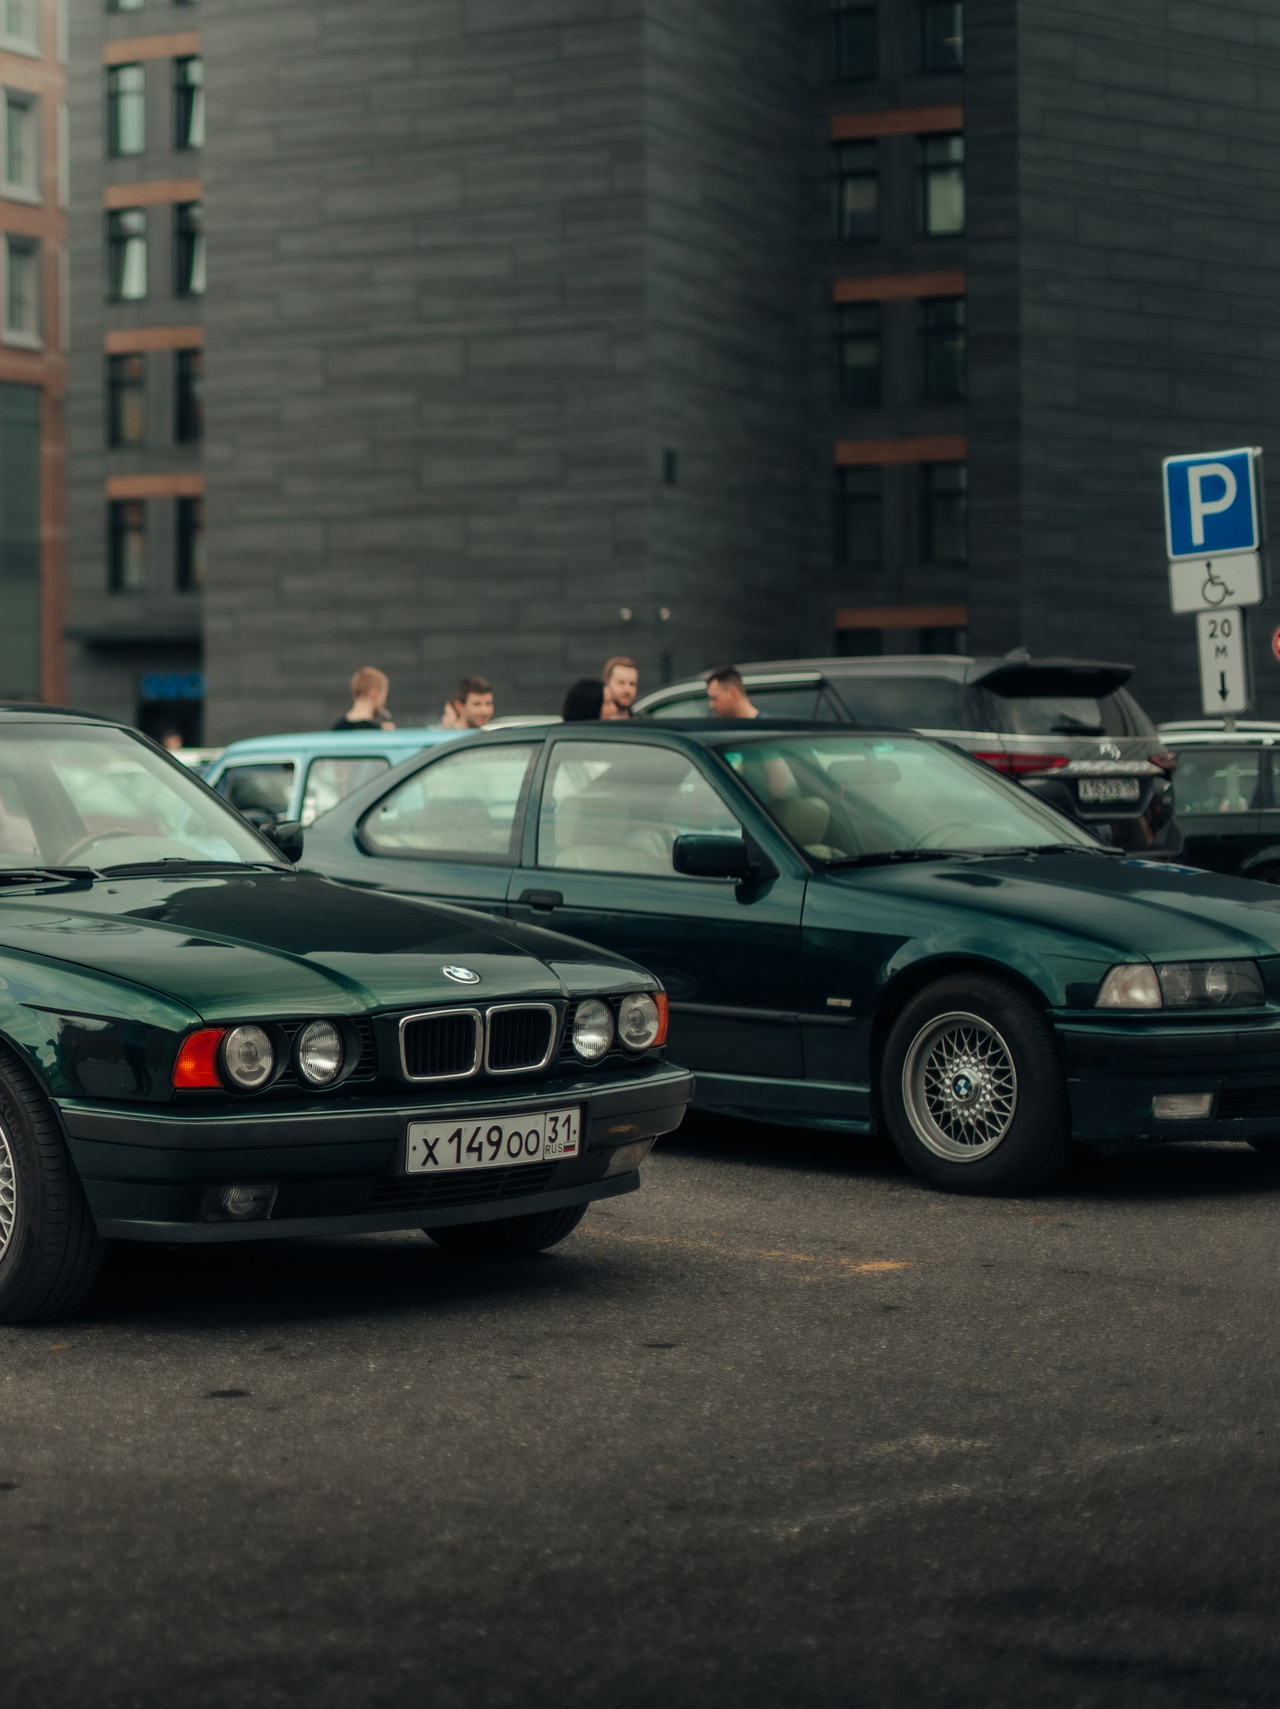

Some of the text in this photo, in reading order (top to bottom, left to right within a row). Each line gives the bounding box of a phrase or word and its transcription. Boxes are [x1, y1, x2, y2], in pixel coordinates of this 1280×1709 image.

[1187, 462, 1237, 546] P
[1208, 618, 1232, 639] 20
[548, 1114, 572, 1143] 31
[545, 1143, 563, 1154] RUS
